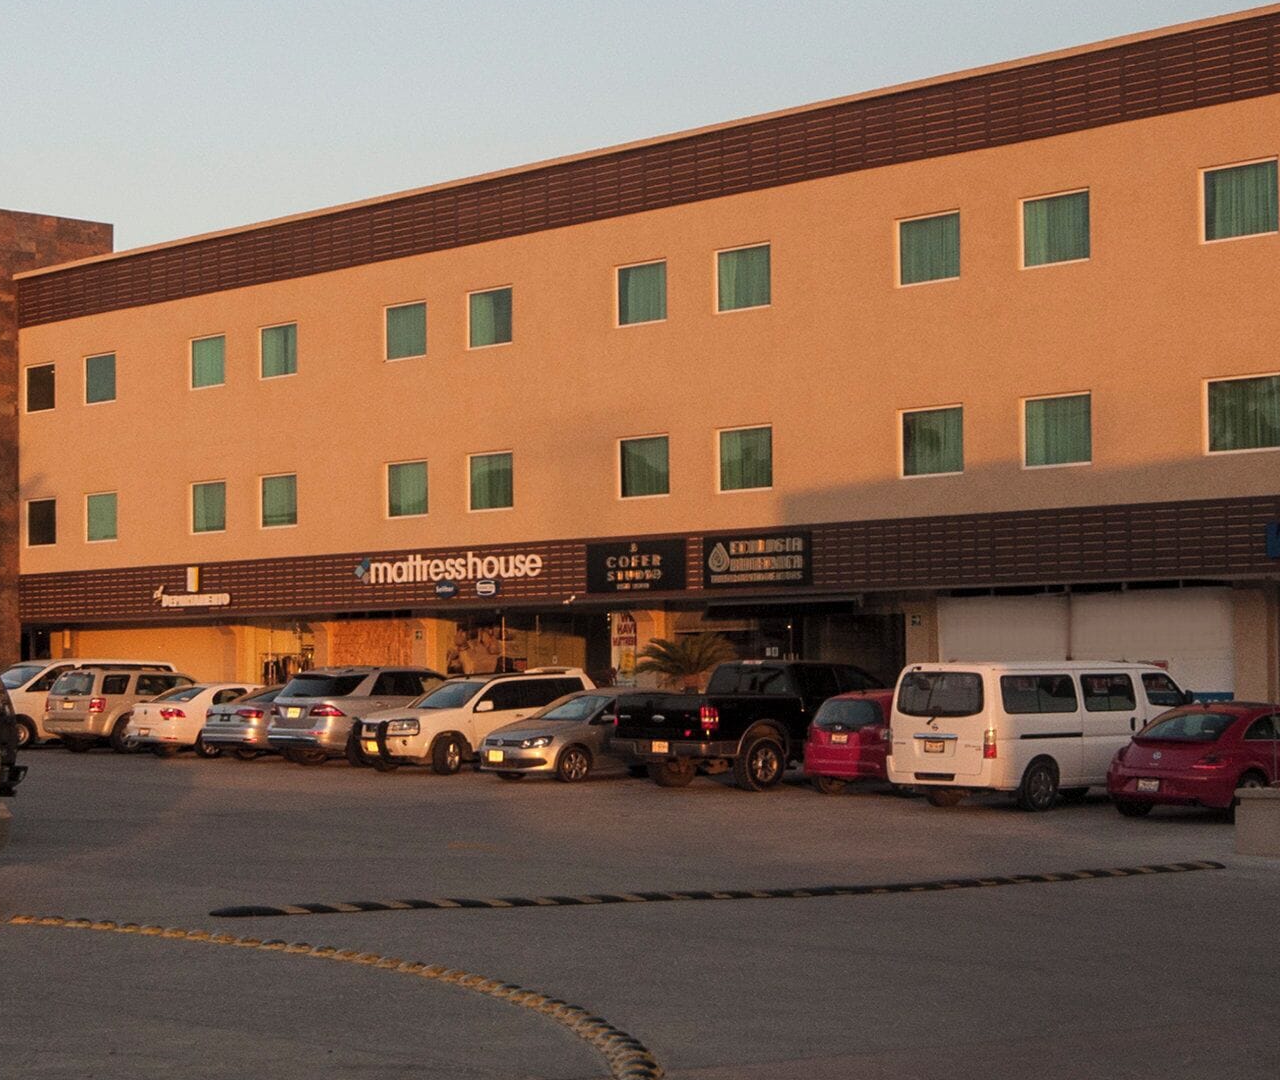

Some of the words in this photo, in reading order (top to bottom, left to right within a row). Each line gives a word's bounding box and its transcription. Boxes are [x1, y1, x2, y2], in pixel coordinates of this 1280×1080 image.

[370, 551, 542, 583] mattresshouse
[606, 554, 662, 568] COFER
[607, 569, 662, 582] STUDIO
